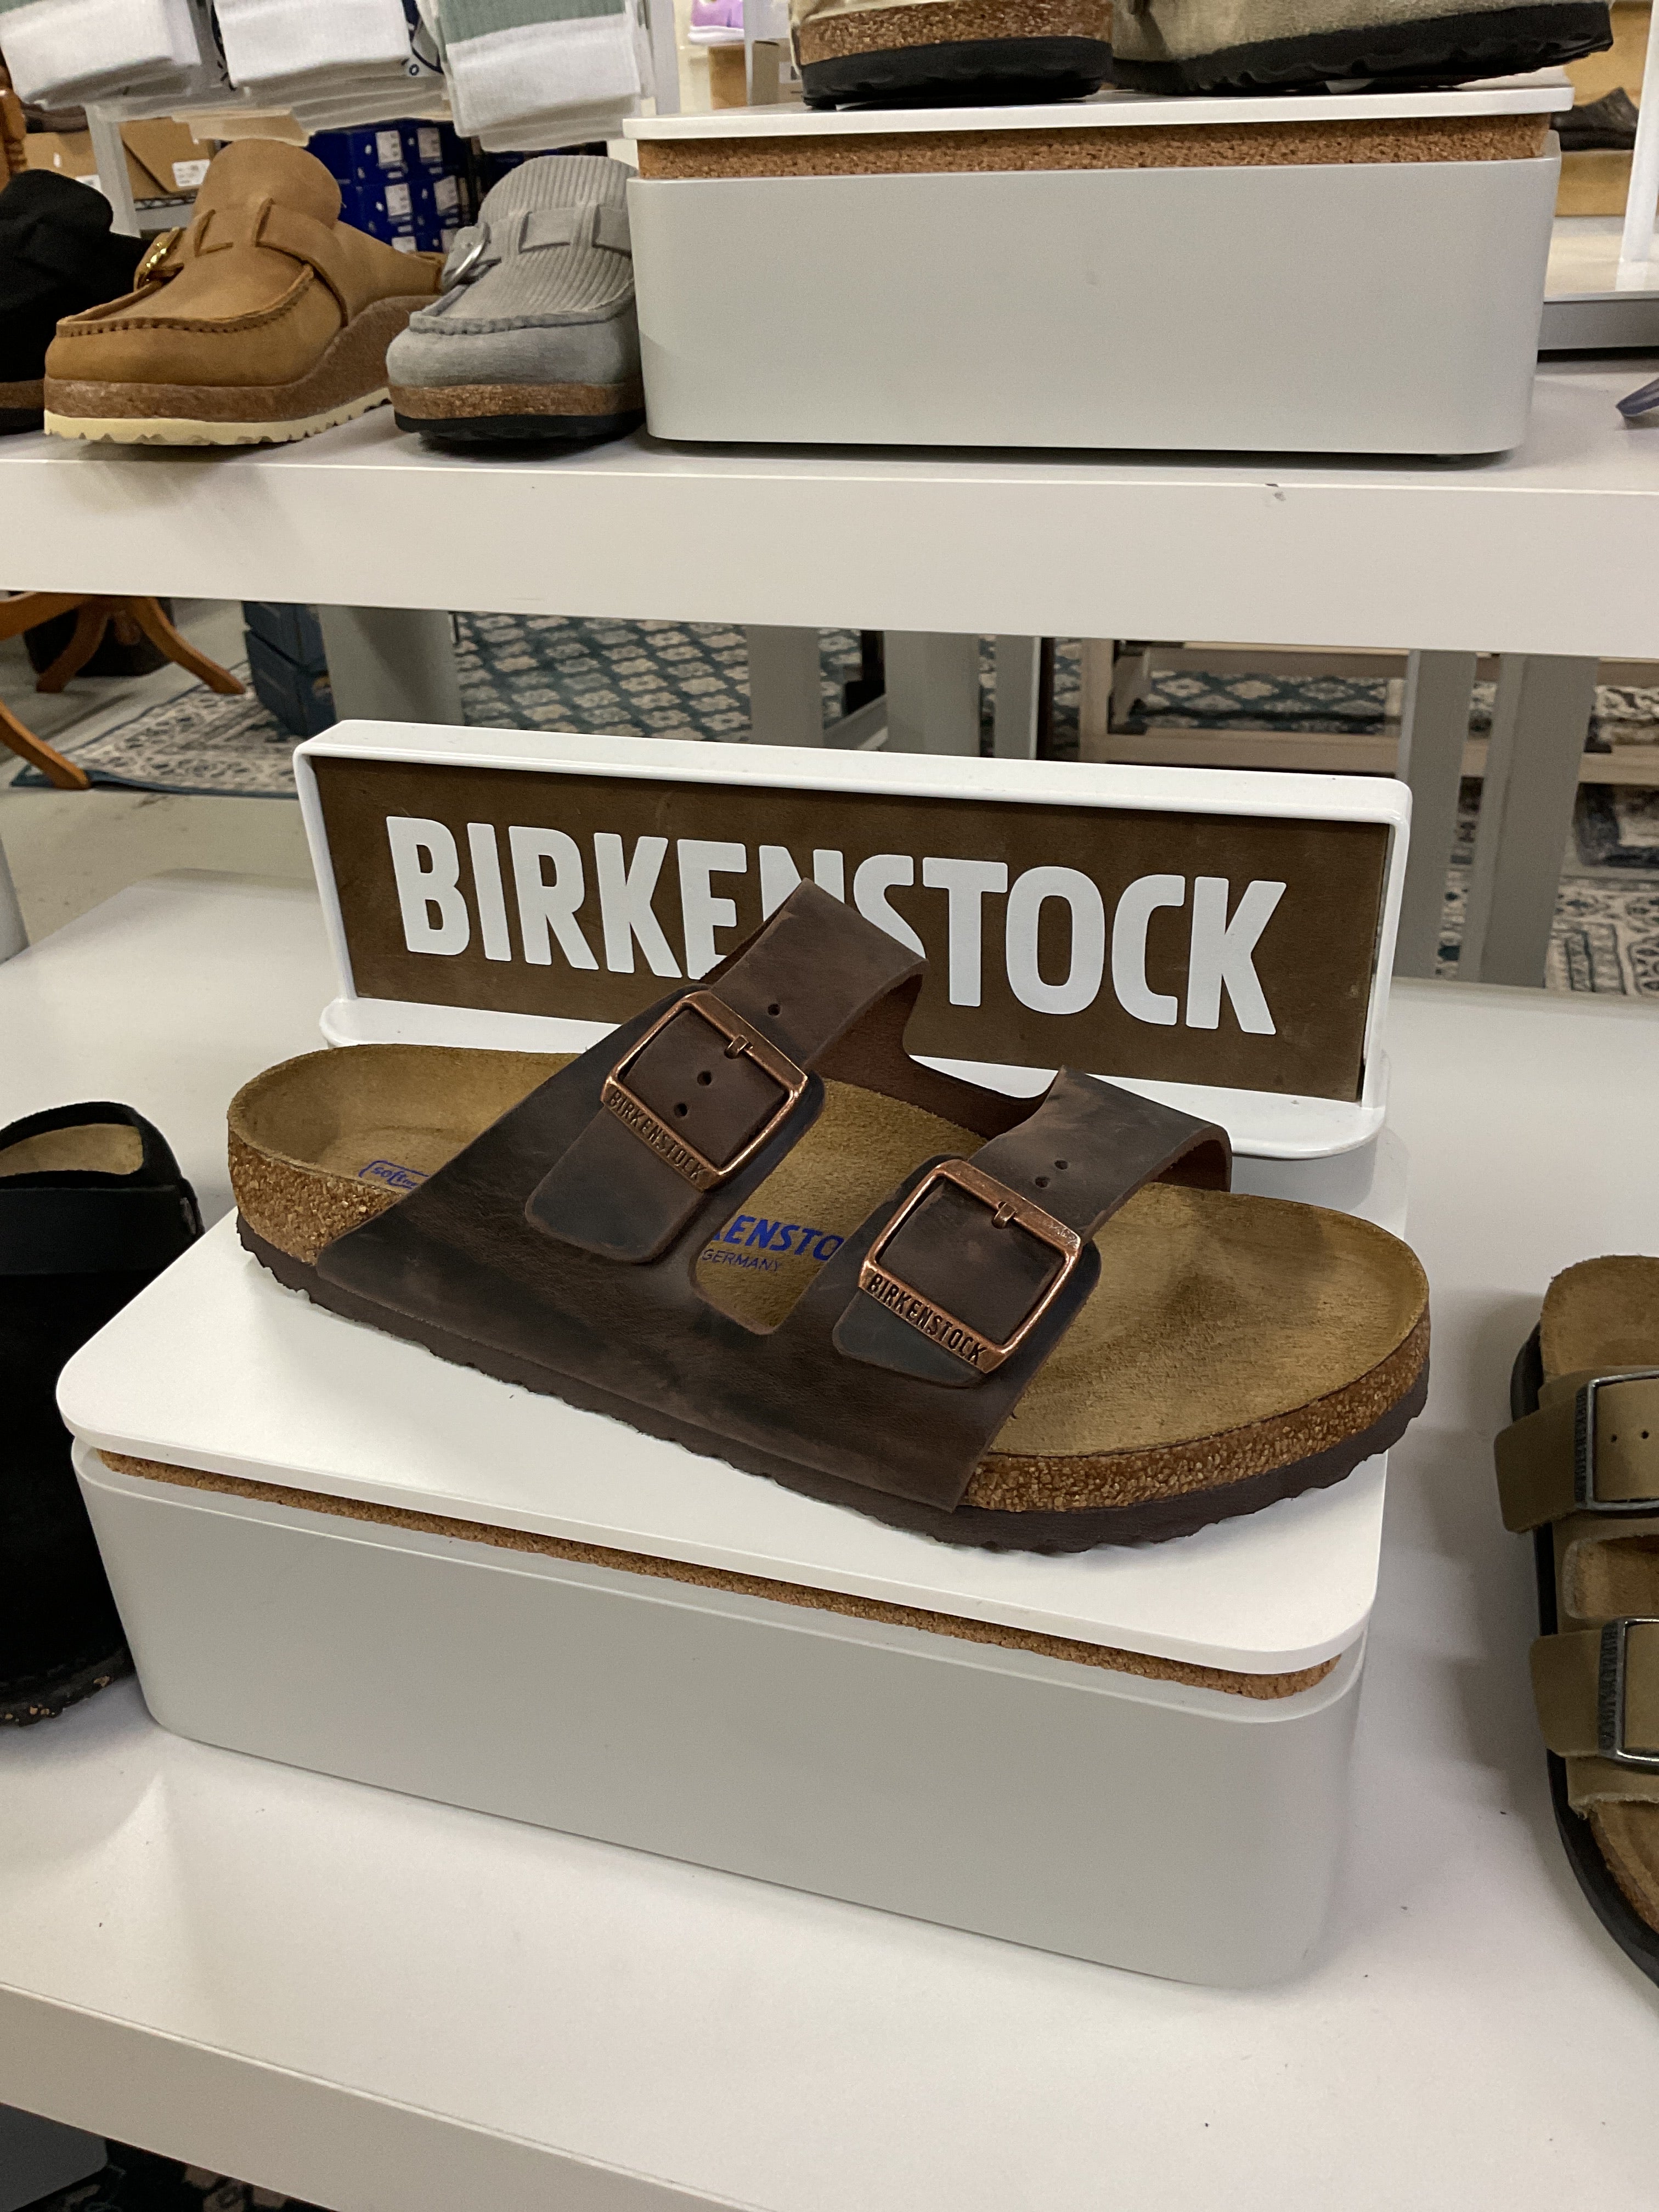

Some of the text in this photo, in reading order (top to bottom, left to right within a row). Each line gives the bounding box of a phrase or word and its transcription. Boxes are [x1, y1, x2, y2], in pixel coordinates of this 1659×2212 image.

[607, 1088, 709, 1180] BIRKENSTOCK
[701, 1249, 782, 1272] GERMANY
[713, 1215, 845, 1261] ENSTO
[867, 1273, 987, 1367] BIRKENSTOCK
